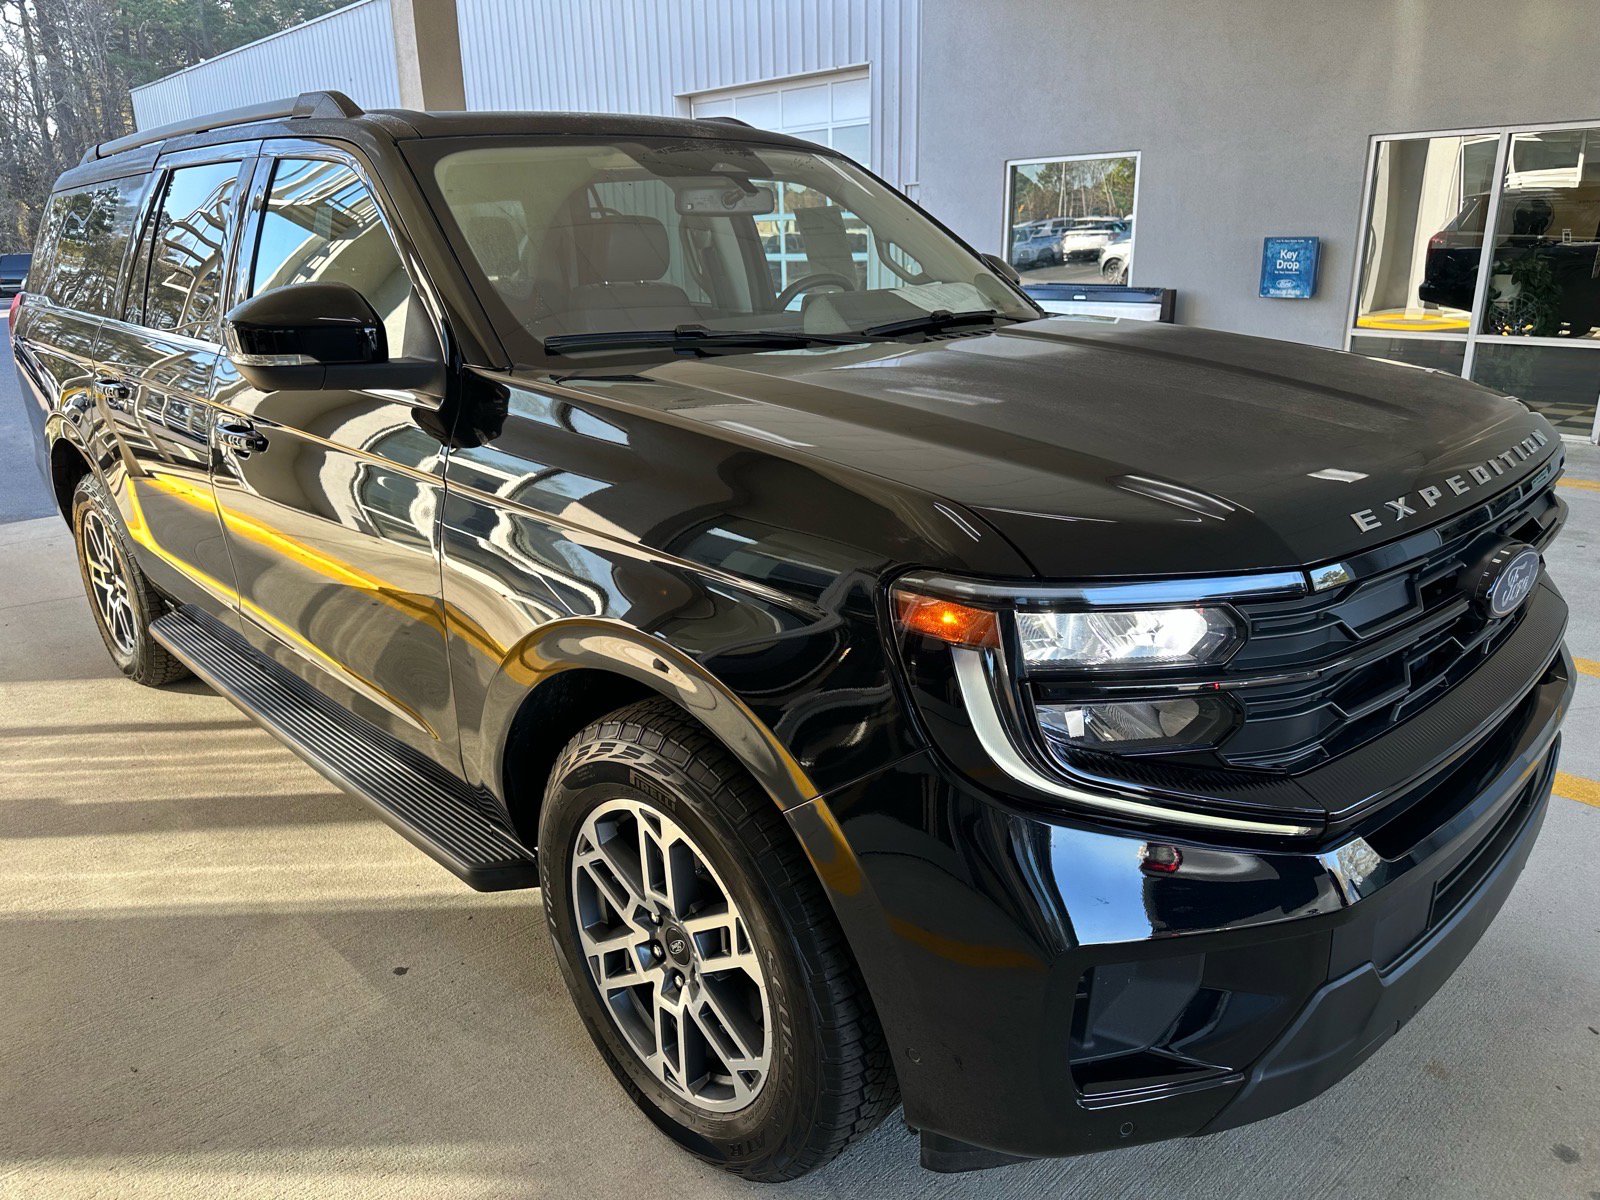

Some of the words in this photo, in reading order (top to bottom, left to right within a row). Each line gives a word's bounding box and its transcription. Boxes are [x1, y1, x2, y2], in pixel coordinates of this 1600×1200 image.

[1276, 260, 1300, 271] Drop
[1280, 249, 1298, 260] Key
[1350, 429, 1549, 533] EXPEDITION
[1501, 560, 1534, 608] Ford
[629, 768, 677, 812] PIRELLI
